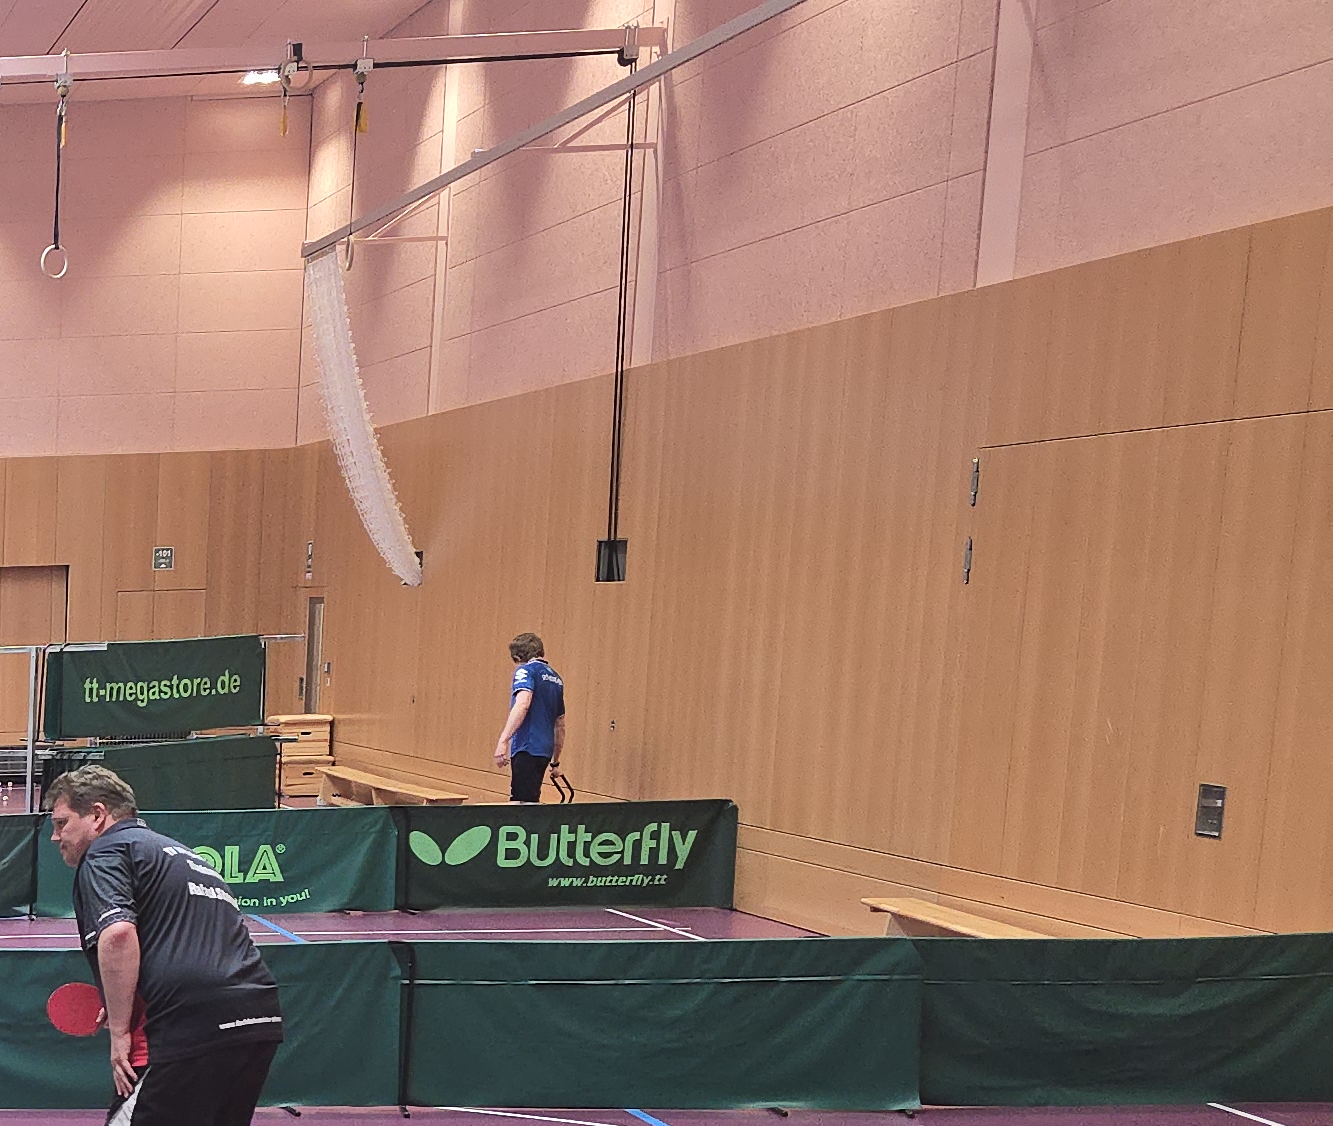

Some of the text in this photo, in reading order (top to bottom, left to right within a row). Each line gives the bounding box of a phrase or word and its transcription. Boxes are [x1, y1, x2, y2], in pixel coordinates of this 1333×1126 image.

[83, 669, 241, 707] tt-megastore.de
[191, 844, 285, 884] OLA
[496, 822, 698, 870] Butterfly
[547, 874, 668, 888] www.butterfly.tt
[263, 898, 277, 907] in
